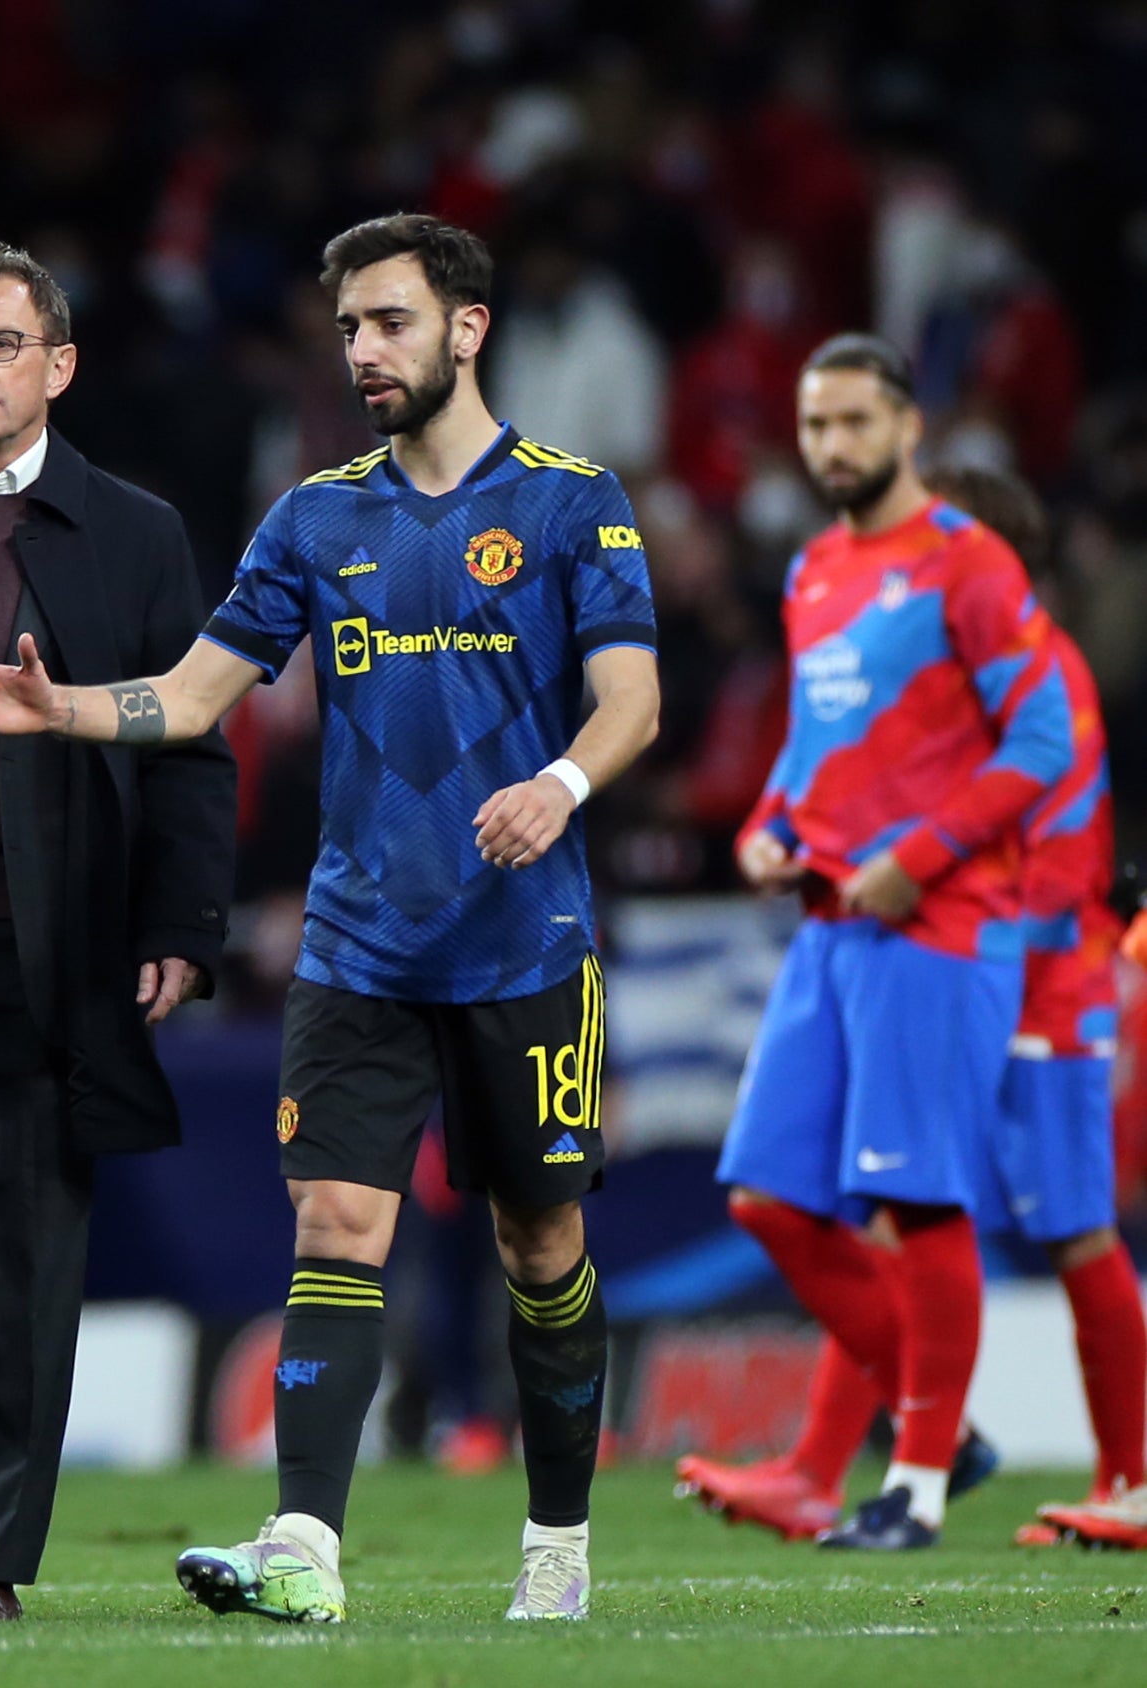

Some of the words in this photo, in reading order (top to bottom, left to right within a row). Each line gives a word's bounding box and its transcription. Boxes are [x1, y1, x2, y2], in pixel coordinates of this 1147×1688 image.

[338, 561, 379, 577] adidas
[370, 625, 518, 655] TeamViewer
[525, 1043, 584, 1128] 18
[543, 1151, 585, 1164] adidas
